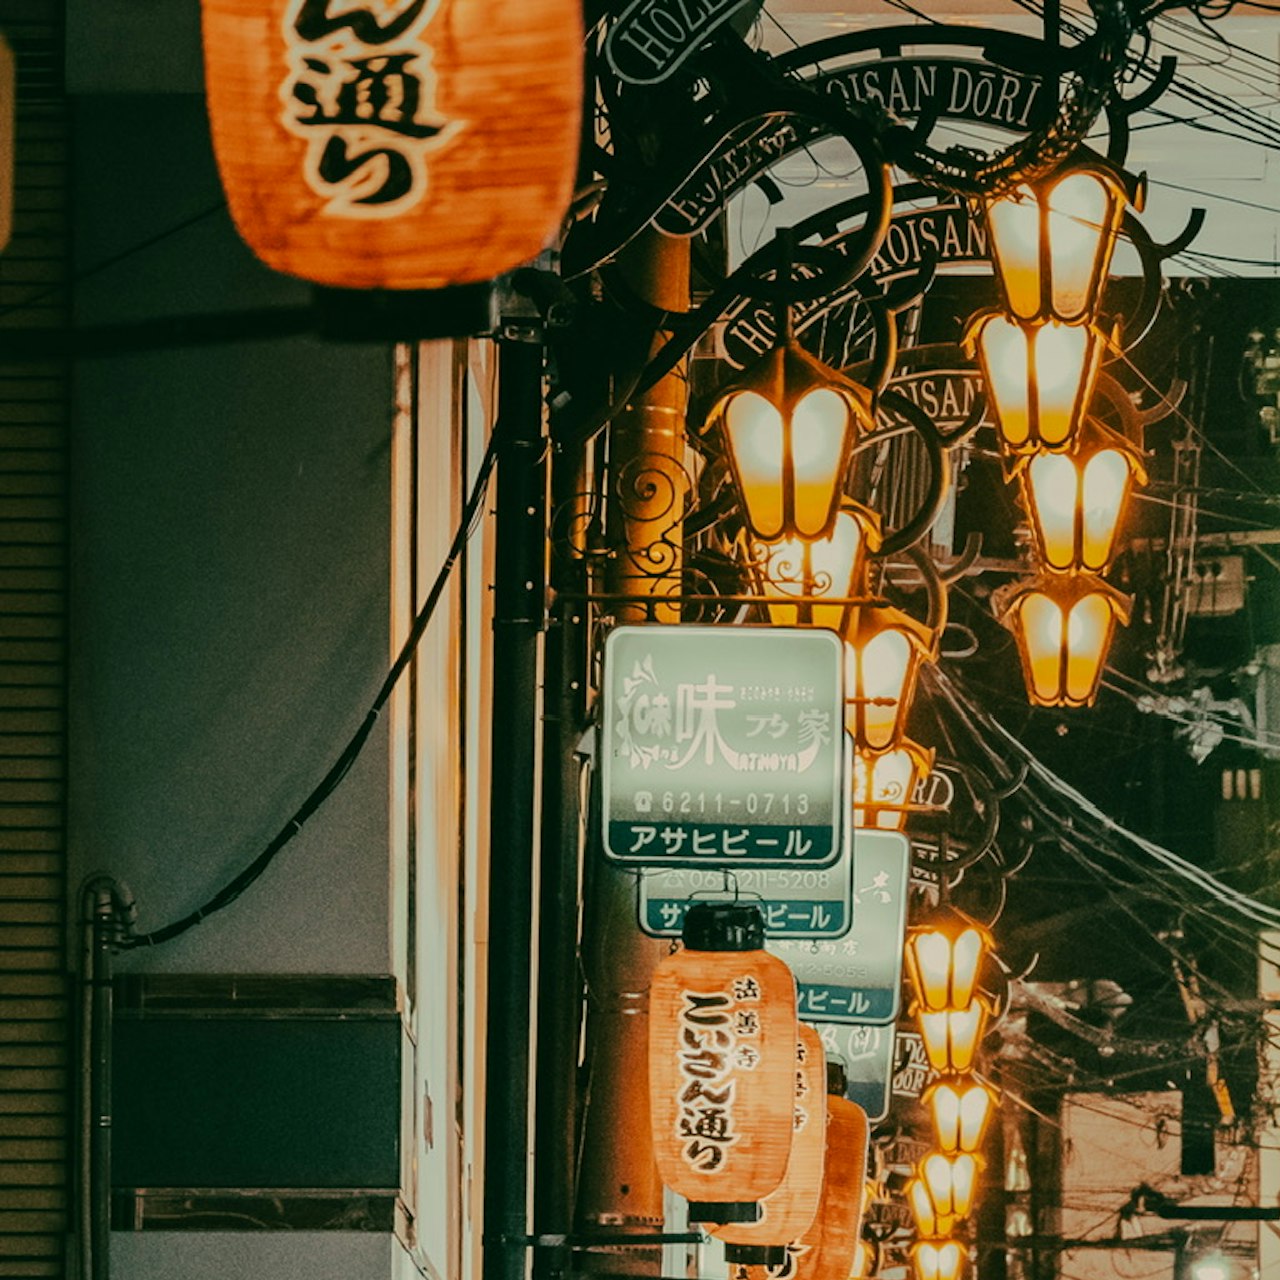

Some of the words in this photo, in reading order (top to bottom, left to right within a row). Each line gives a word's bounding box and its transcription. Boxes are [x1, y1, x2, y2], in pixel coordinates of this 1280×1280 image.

[662, 791, 810, 815] 6211-0713
[629, 825, 813, 857] アサヒビール
